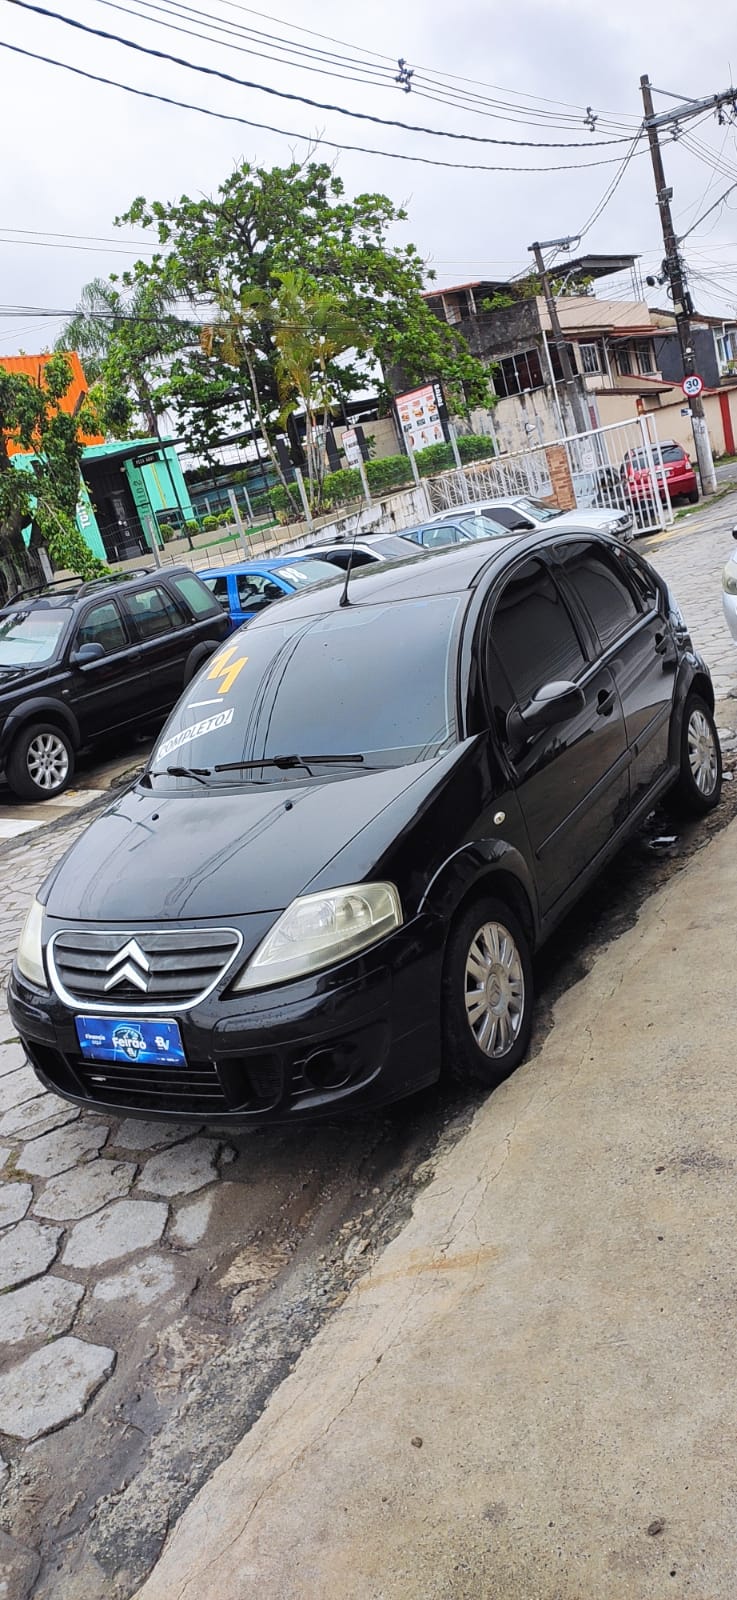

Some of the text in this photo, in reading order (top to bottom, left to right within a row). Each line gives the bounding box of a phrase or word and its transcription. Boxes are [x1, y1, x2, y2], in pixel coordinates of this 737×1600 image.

[686, 379, 699, 390] 30
[278, 567, 307, 582] 98
[207, 646, 248, 694] 11
[158, 709, 233, 757] COMPLETO!
[112, 1034, 146, 1050] Feirão
